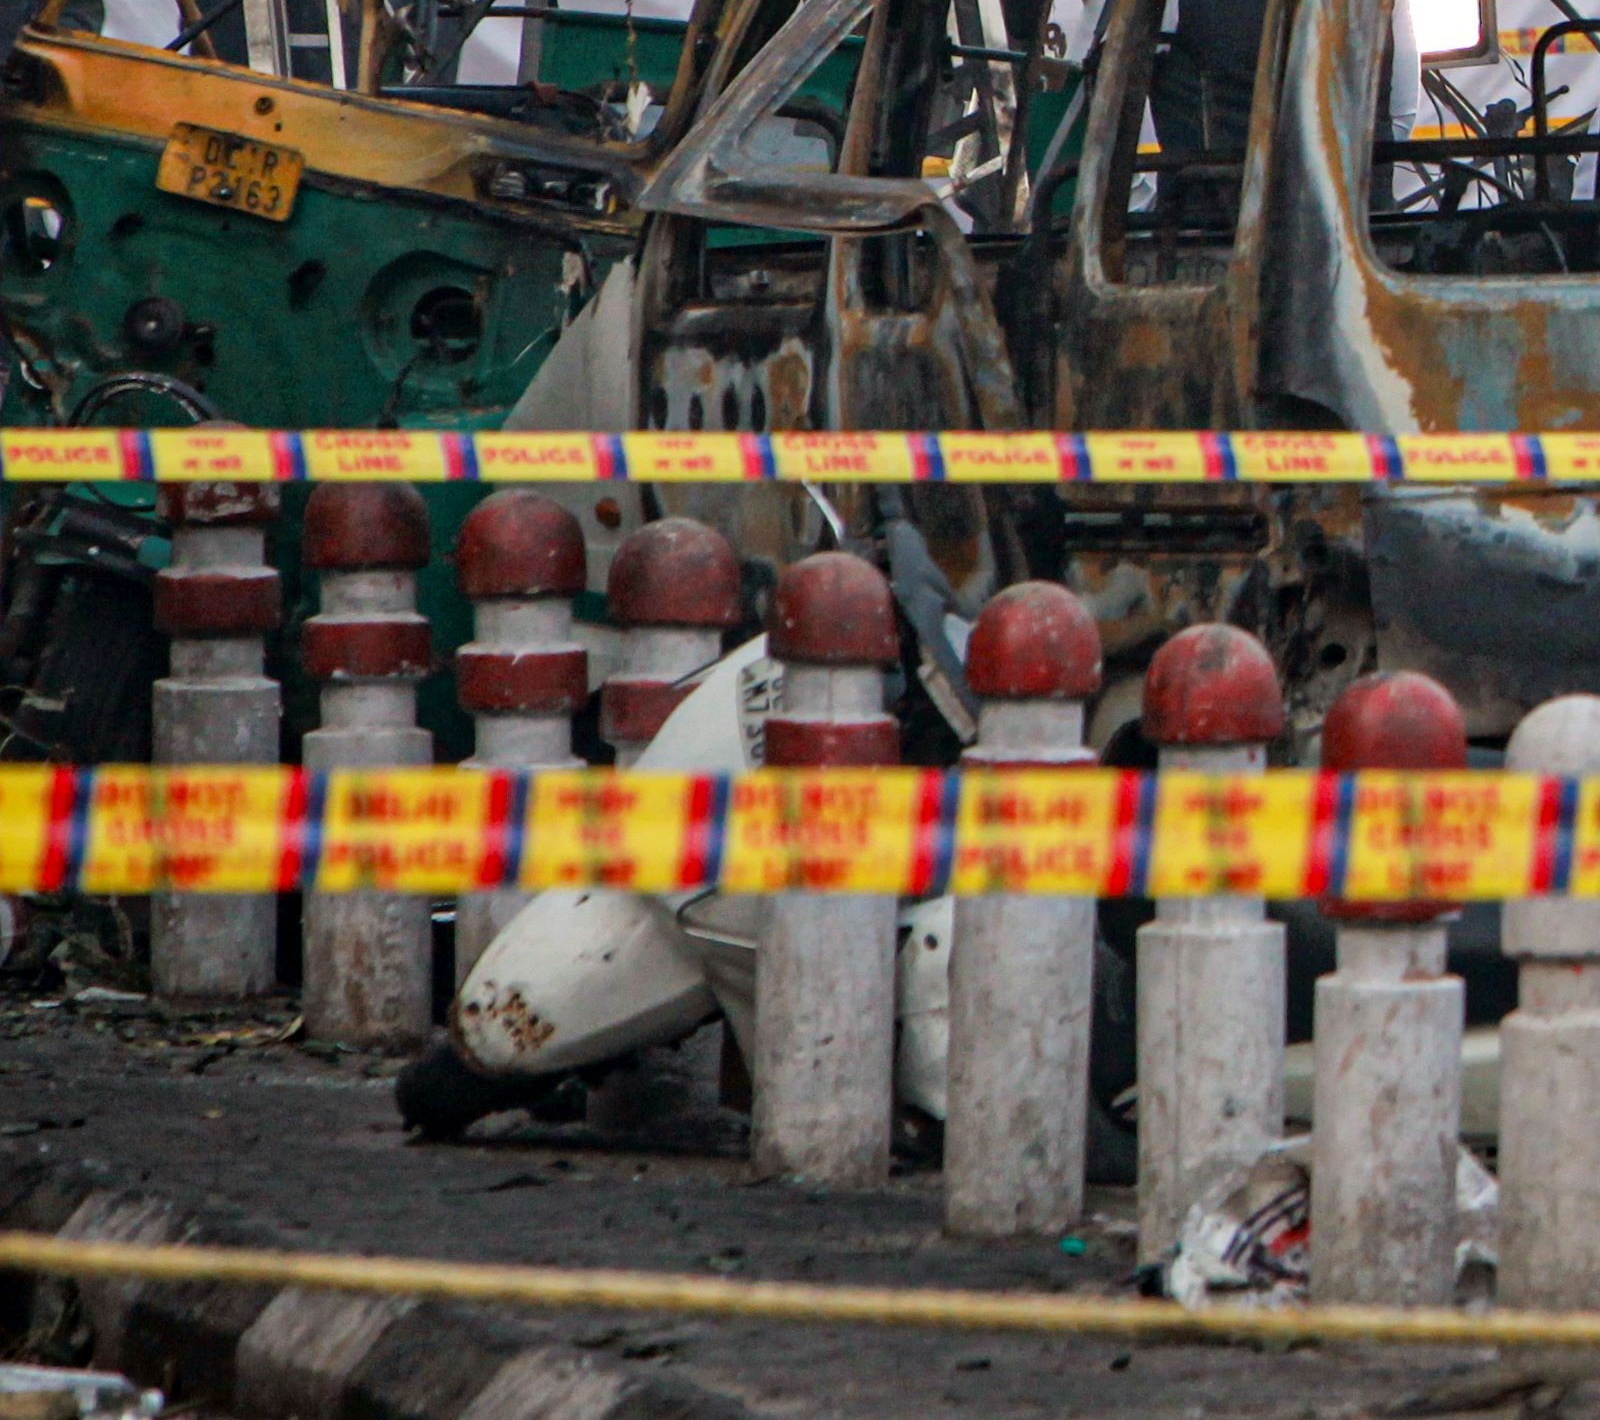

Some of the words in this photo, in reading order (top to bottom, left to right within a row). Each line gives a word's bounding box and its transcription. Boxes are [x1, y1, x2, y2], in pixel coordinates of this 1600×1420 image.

[7, 447, 112, 464] POLICE
[338, 456, 403, 471] LINE
[484, 448, 584, 464] POLICE
[806, 456, 870, 471] LINE
[951, 449, 1050, 465] POLICE
[1407, 451, 1506, 466] POLICE
[1267, 456, 1327, 472] LINE
